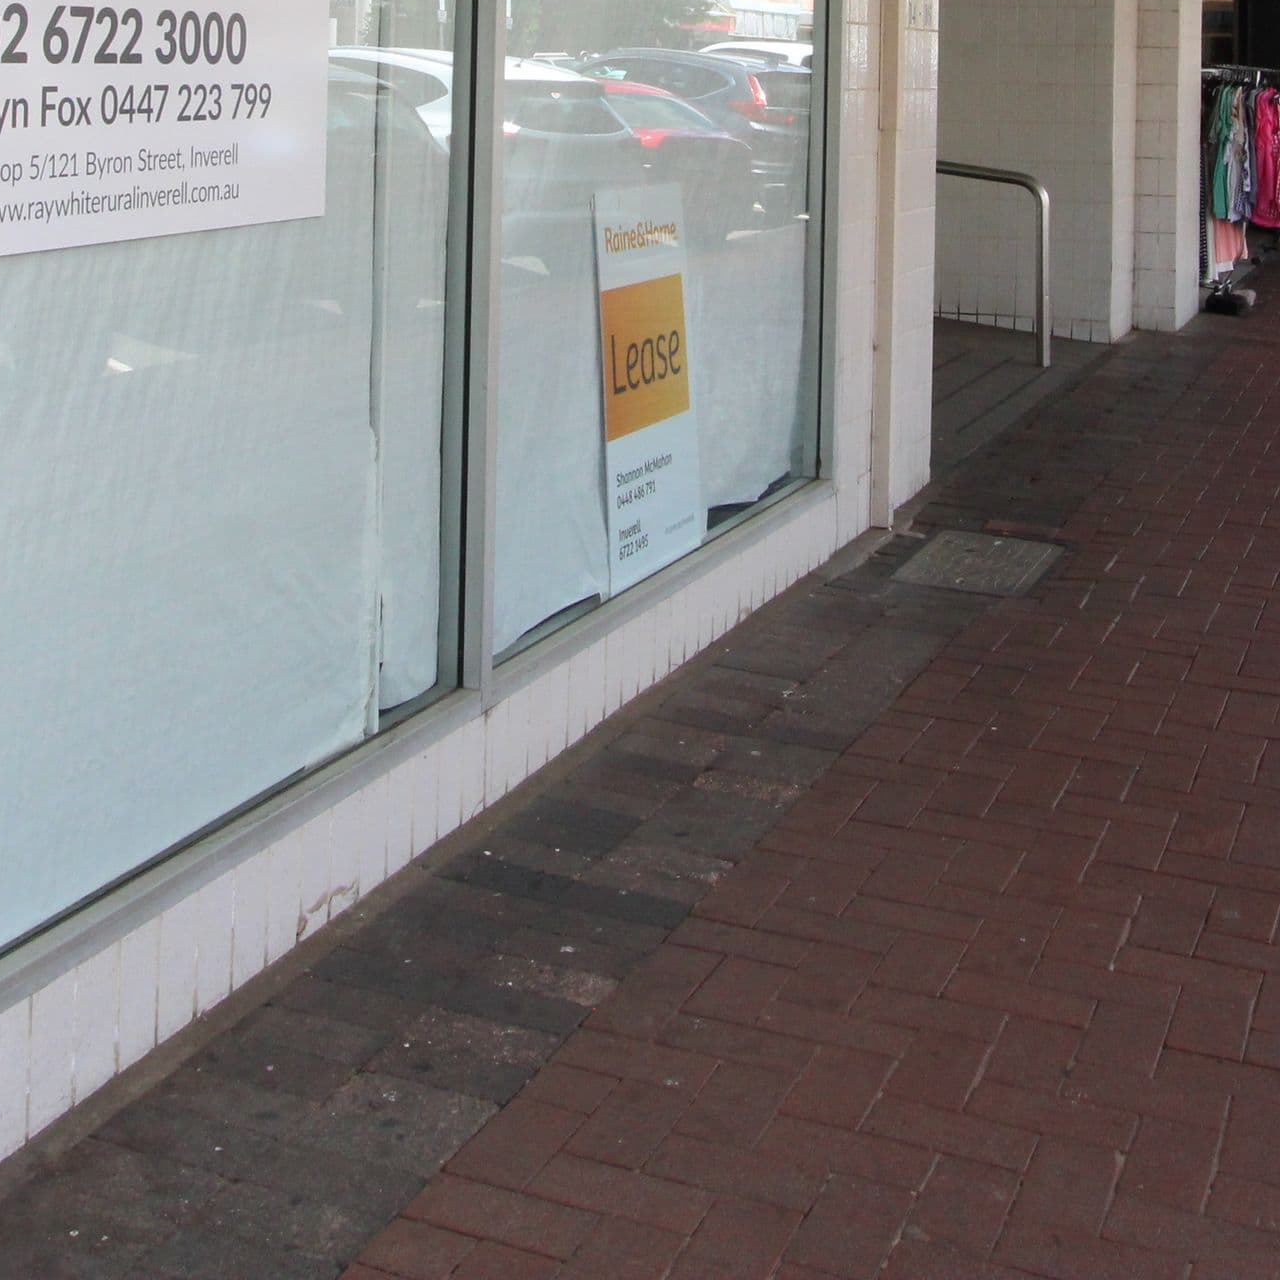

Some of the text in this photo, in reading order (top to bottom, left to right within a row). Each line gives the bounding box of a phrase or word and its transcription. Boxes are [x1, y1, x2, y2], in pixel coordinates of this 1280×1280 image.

[42, 5, 143, 64] 6722
[155, 9, 247, 64] 3000
[41, 86, 92, 127] Fox
[100, 85, 169, 125] 0447
[176, 83, 222, 122] 223
[230, 83, 272, 120] 799
[29, 153, 79, 181] 5/121
[86, 151, 133, 180] Byron
[138, 148, 185, 173] Street,
[190, 142, 239, 169] Inverell
[611, 329, 681, 396] Lease
[616, 453, 673, 488] Shannon McMahon
[619, 519, 641, 541] Inverell
